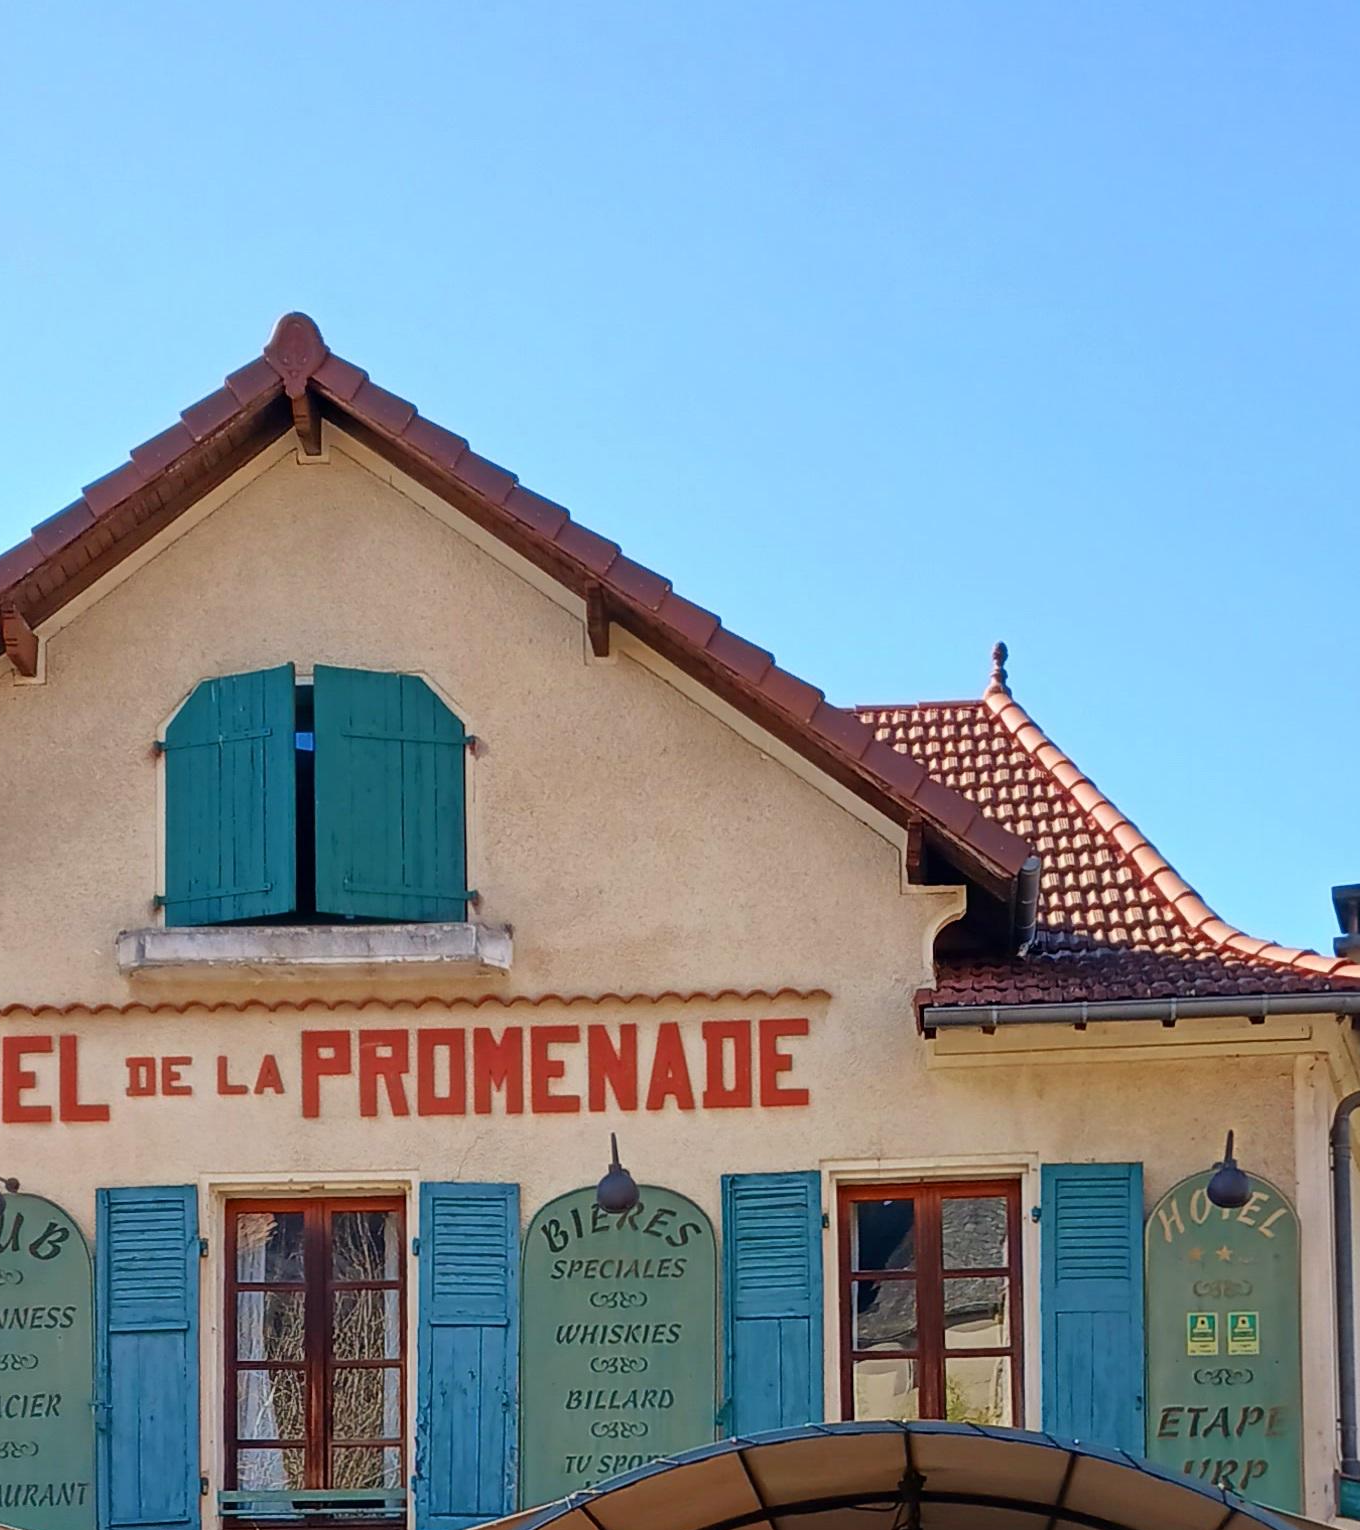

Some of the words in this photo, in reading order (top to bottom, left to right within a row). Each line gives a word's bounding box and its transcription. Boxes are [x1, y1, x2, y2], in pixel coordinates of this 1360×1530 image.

[126, 1056, 192, 1096] DE
[217, 1054, 285, 1095] LA
[301, 1018, 809, 1118] PROMENADE
[551, 1258, 688, 1279] SPECIALES
[555, 1324, 682, 1345] WHISKIES
[565, 1389, 674, 1411] BILLARD
[1157, 1406, 1289, 1438] ETAPE
[565, 1455, 592, 1474] TV
